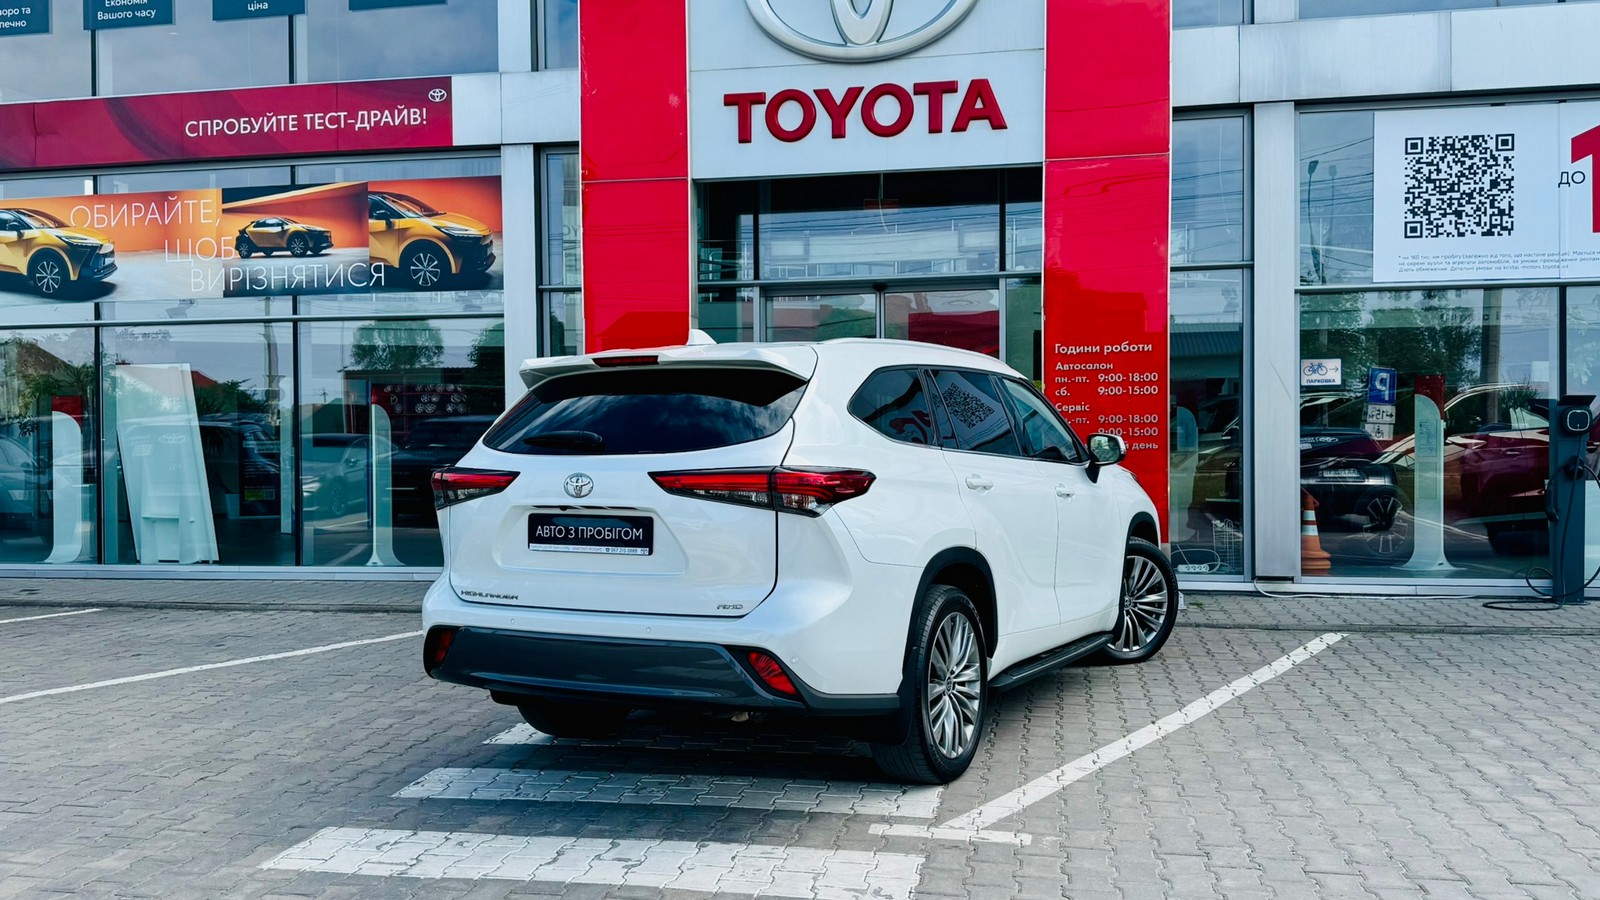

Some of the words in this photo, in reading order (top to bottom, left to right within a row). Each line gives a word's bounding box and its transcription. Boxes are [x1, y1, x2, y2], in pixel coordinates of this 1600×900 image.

[247, 0, 268, 11] ціна
[97, 10, 133, 20] Вашого
[134, 9, 157, 18] часу
[723, 78, 1008, 144] TOYOTA
[185, 113, 299, 138] СПРОБУЙТЕ
[303, 104, 428, 132] ТЕСТ-ДРАЙВ!
[1558, 171, 1586, 188] ДО
[70, 196, 222, 228] ОБИРАЙТЕ,
[164, 237, 237, 263] ЩОБ
[190, 262, 386, 292] ВИРІЗНЯТИСЯ
[1055, 343, 1100, 354] Години
[1104, 341, 1152, 355] роботи
[1055, 362, 1113, 371] Автосалон
[1055, 375, 1090, 384] пн.-пт.
[1098, 372, 1158, 383] 9:00-18:00
[1055, 386, 1071, 397] сб.
[1098, 386, 1158, 396] 9:00-15:00
[1055, 402, 1090, 413] Сервіс
[1065, 416, 1090, 425] .-пт.
[1098, 414, 1158, 424] 9:00-18:00
[1132, 442, 1159, 451] день
[536, 525, 565, 538] АВТО
[578, 527, 643, 540] ПРОБІГОМ
